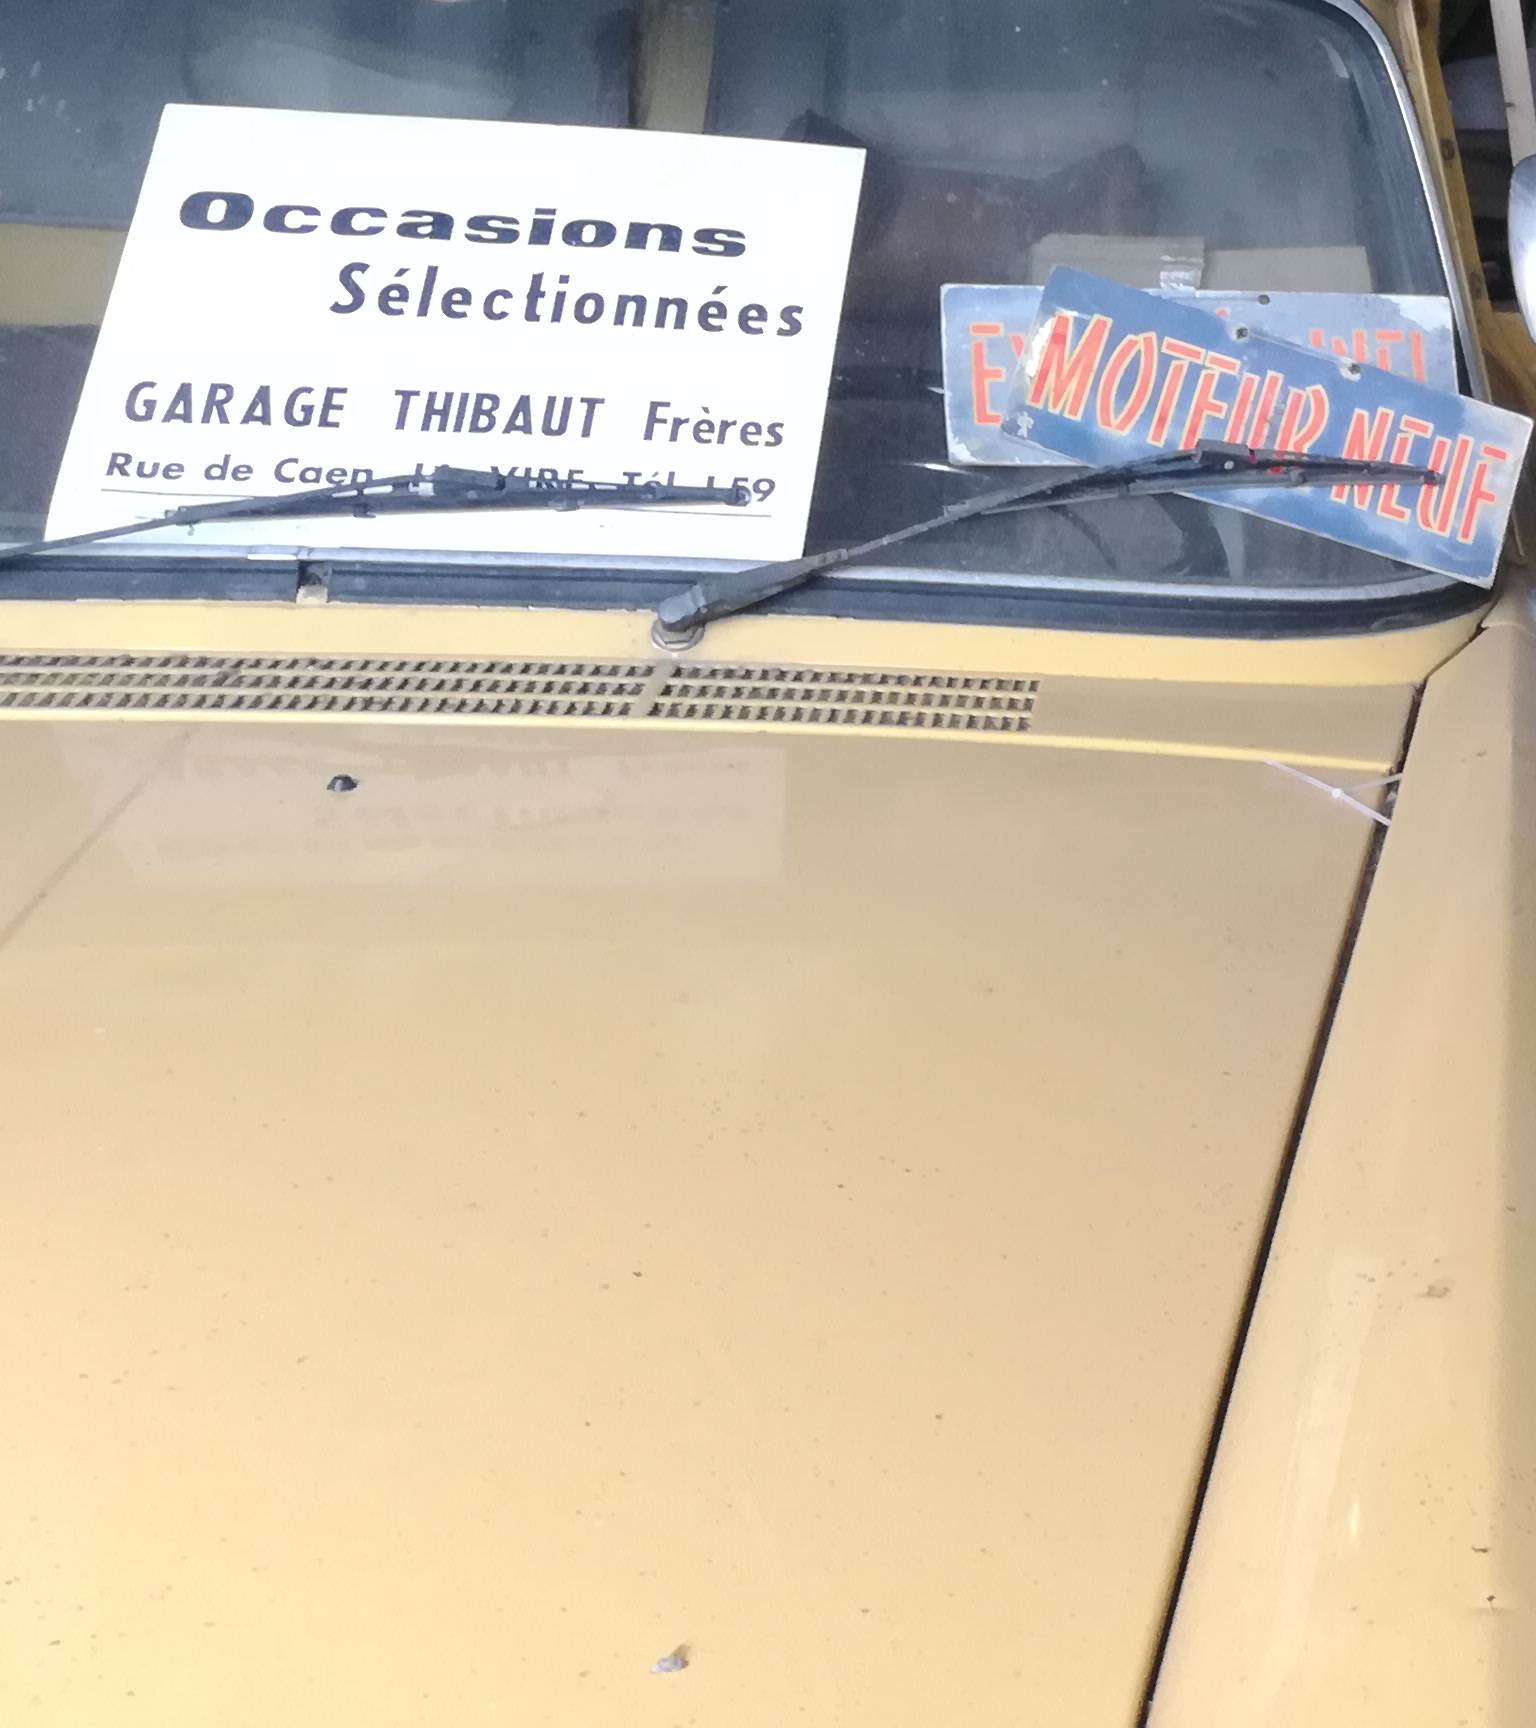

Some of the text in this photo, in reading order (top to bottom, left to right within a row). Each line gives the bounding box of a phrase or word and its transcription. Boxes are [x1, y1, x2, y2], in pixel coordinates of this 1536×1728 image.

[178, 190, 748, 259] Occasions
[329, 261, 805, 339] Sélectionnées
[124, 381, 785, 450] GARAGE THIBAUT Frères
[105, 451, 185, 482] Rue
[203, 453, 254, 484] de
[1330, 405, 1509, 545] NEUF
